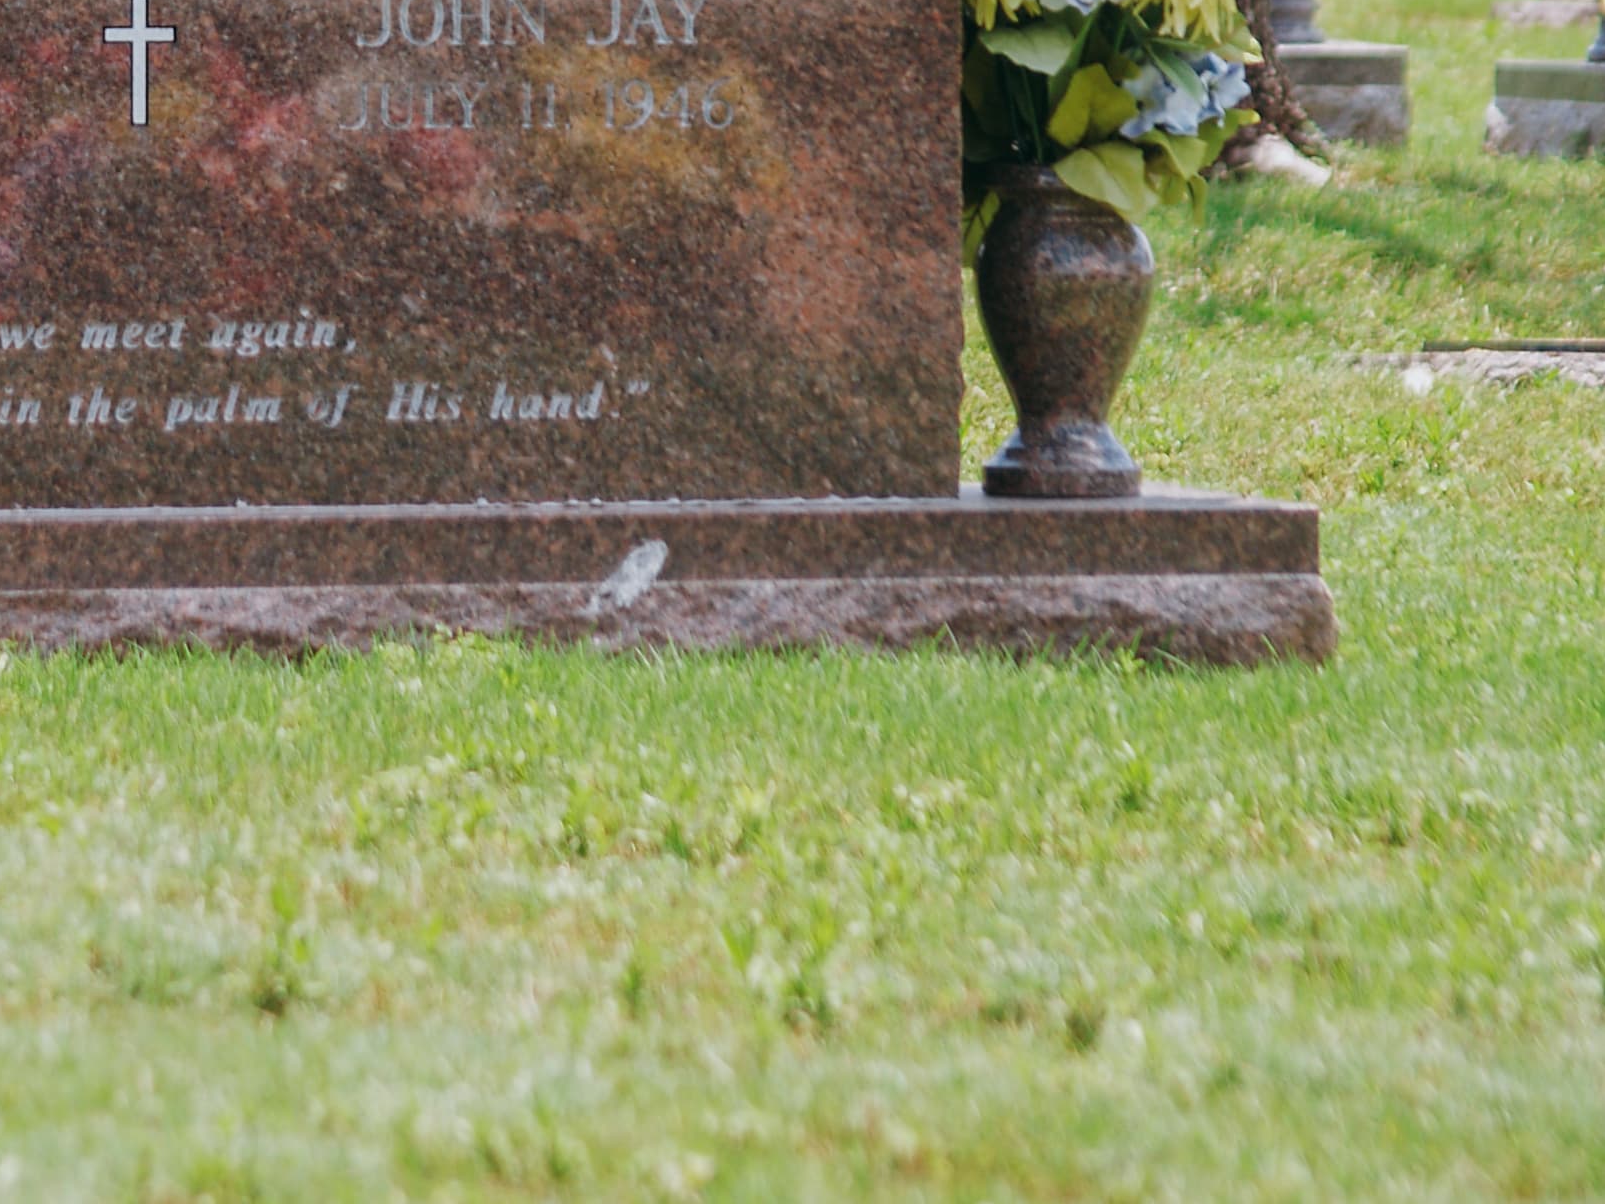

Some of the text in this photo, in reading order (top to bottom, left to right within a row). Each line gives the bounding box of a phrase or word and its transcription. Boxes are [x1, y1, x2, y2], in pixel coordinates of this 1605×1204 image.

[338, 80, 490, 132] JULY
[600, 77, 736, 131] 1946
[80, 315, 187, 351] meet
[207, 305, 358, 357] again,
[67, 386, 136, 428] the
[164, 384, 282, 433] palm
[305, 381, 360, 429] of
[385, 380, 464, 422] His
